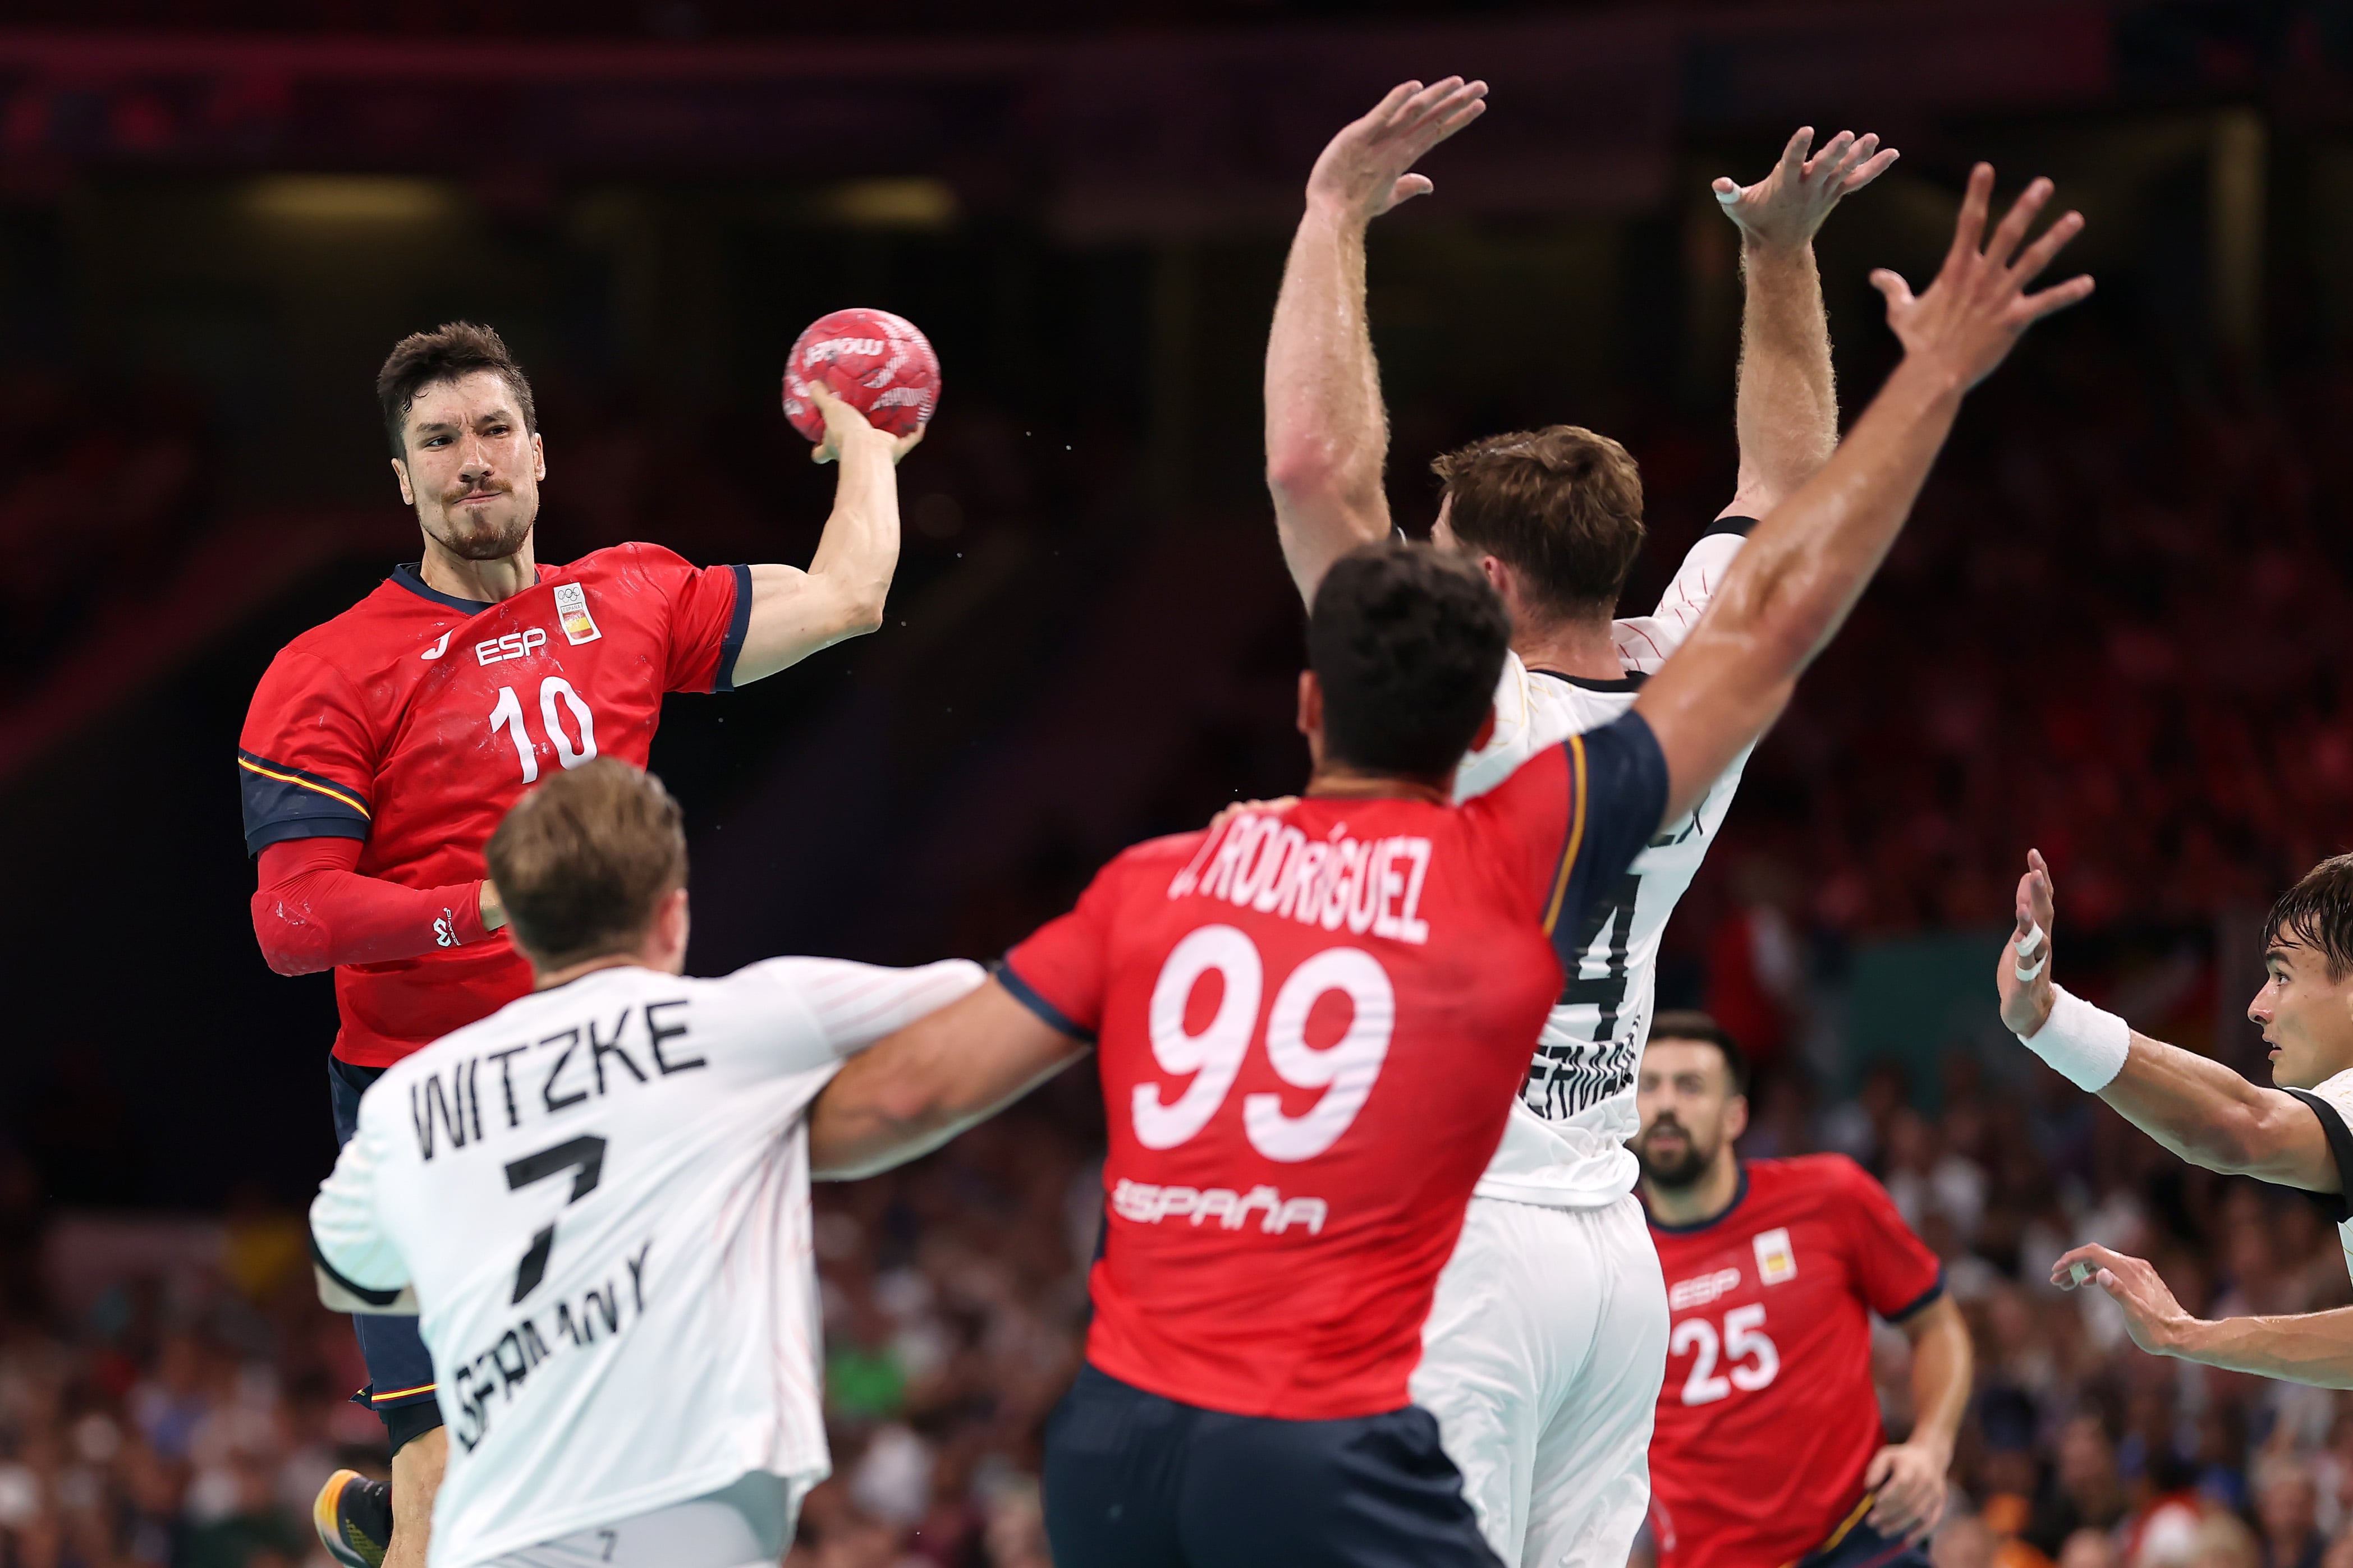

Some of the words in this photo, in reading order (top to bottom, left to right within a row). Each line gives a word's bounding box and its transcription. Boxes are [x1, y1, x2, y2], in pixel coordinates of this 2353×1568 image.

[475, 628, 547, 666] ESP
[562, 604, 581, 613] ESPAÑA
[489, 676, 598, 784] 10
[1198, 812, 1432, 945] RODRÍGUEZ
[411, 999, 707, 1161] WITZKE
[1130, 923, 1397, 1164] 99
[504, 1135, 607, 1305] 7
[1669, 1267, 1741, 1312] ESP
[1669, 1301, 1781, 1406] 25
[598, 1530, 617, 1562] 7
